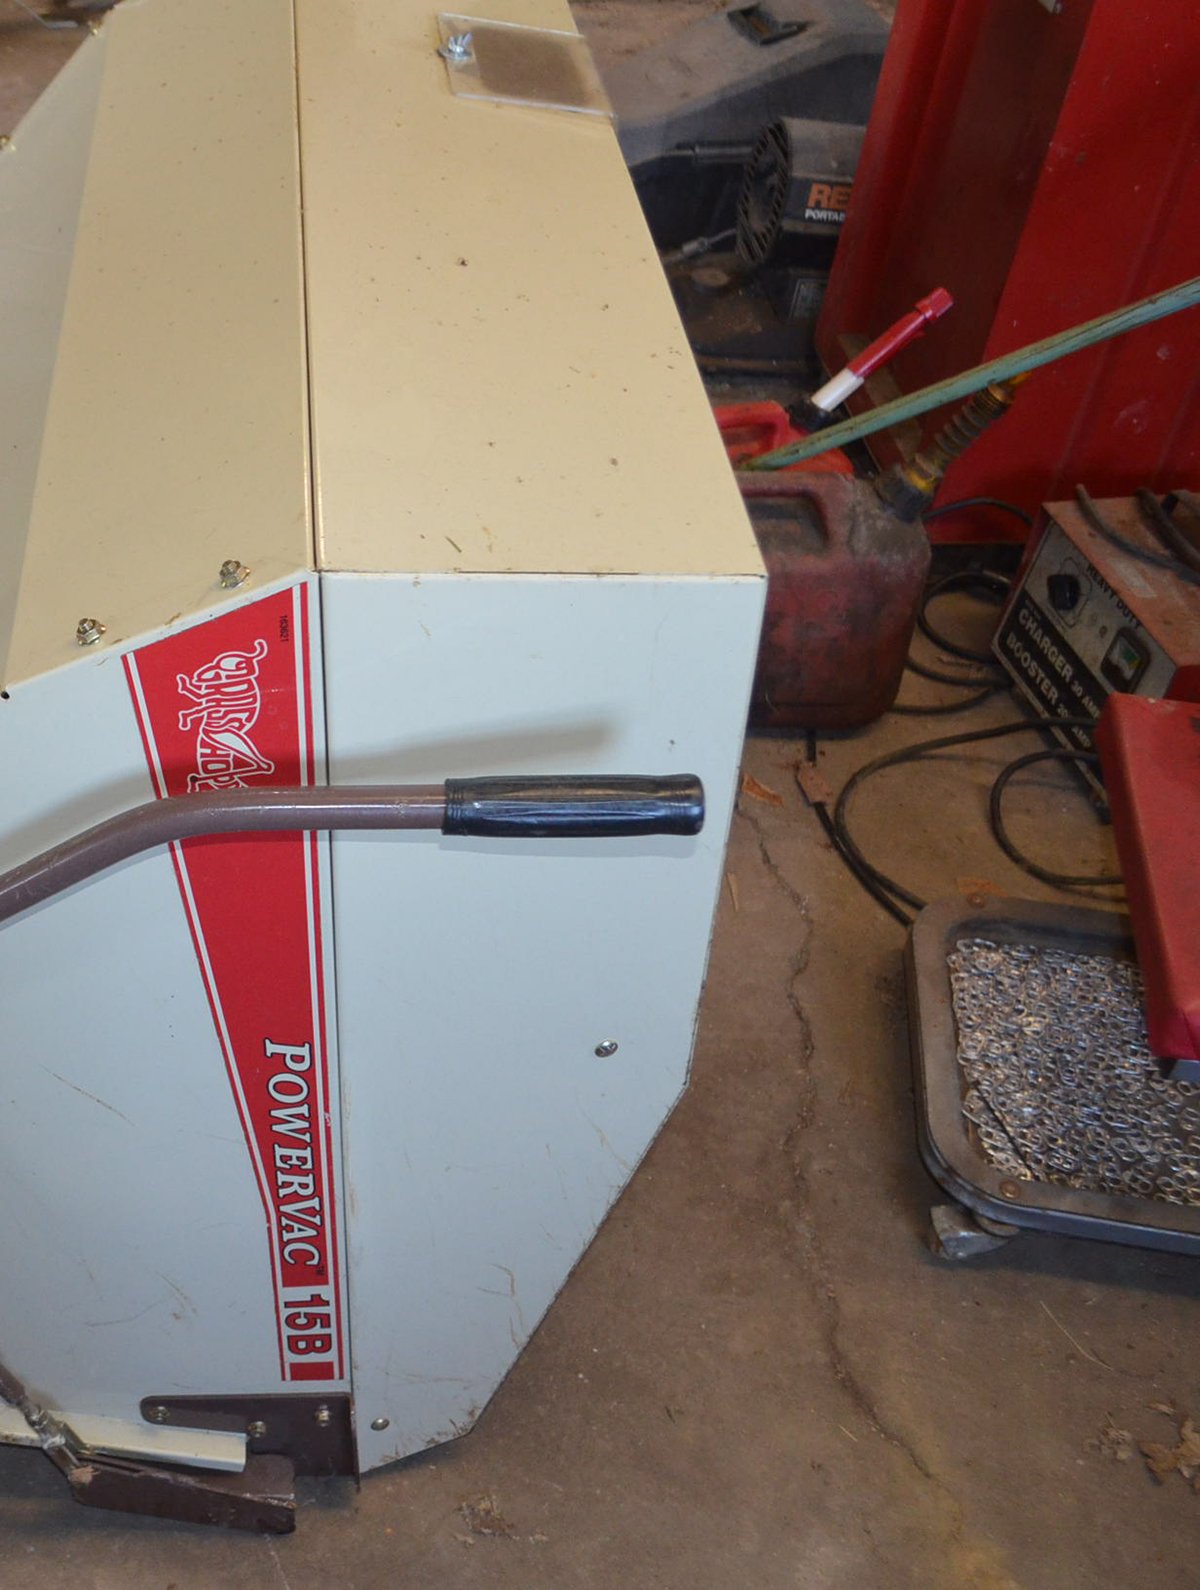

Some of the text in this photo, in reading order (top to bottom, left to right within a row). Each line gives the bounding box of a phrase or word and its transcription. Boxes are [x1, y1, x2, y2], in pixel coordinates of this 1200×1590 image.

[1007, 631, 1058, 706] BOOSTER
[1019, 608, 1073, 683] CHARGER
[264, 1038, 325, 1267] POWERVAC
[284, 1294, 332, 1355] 15B
